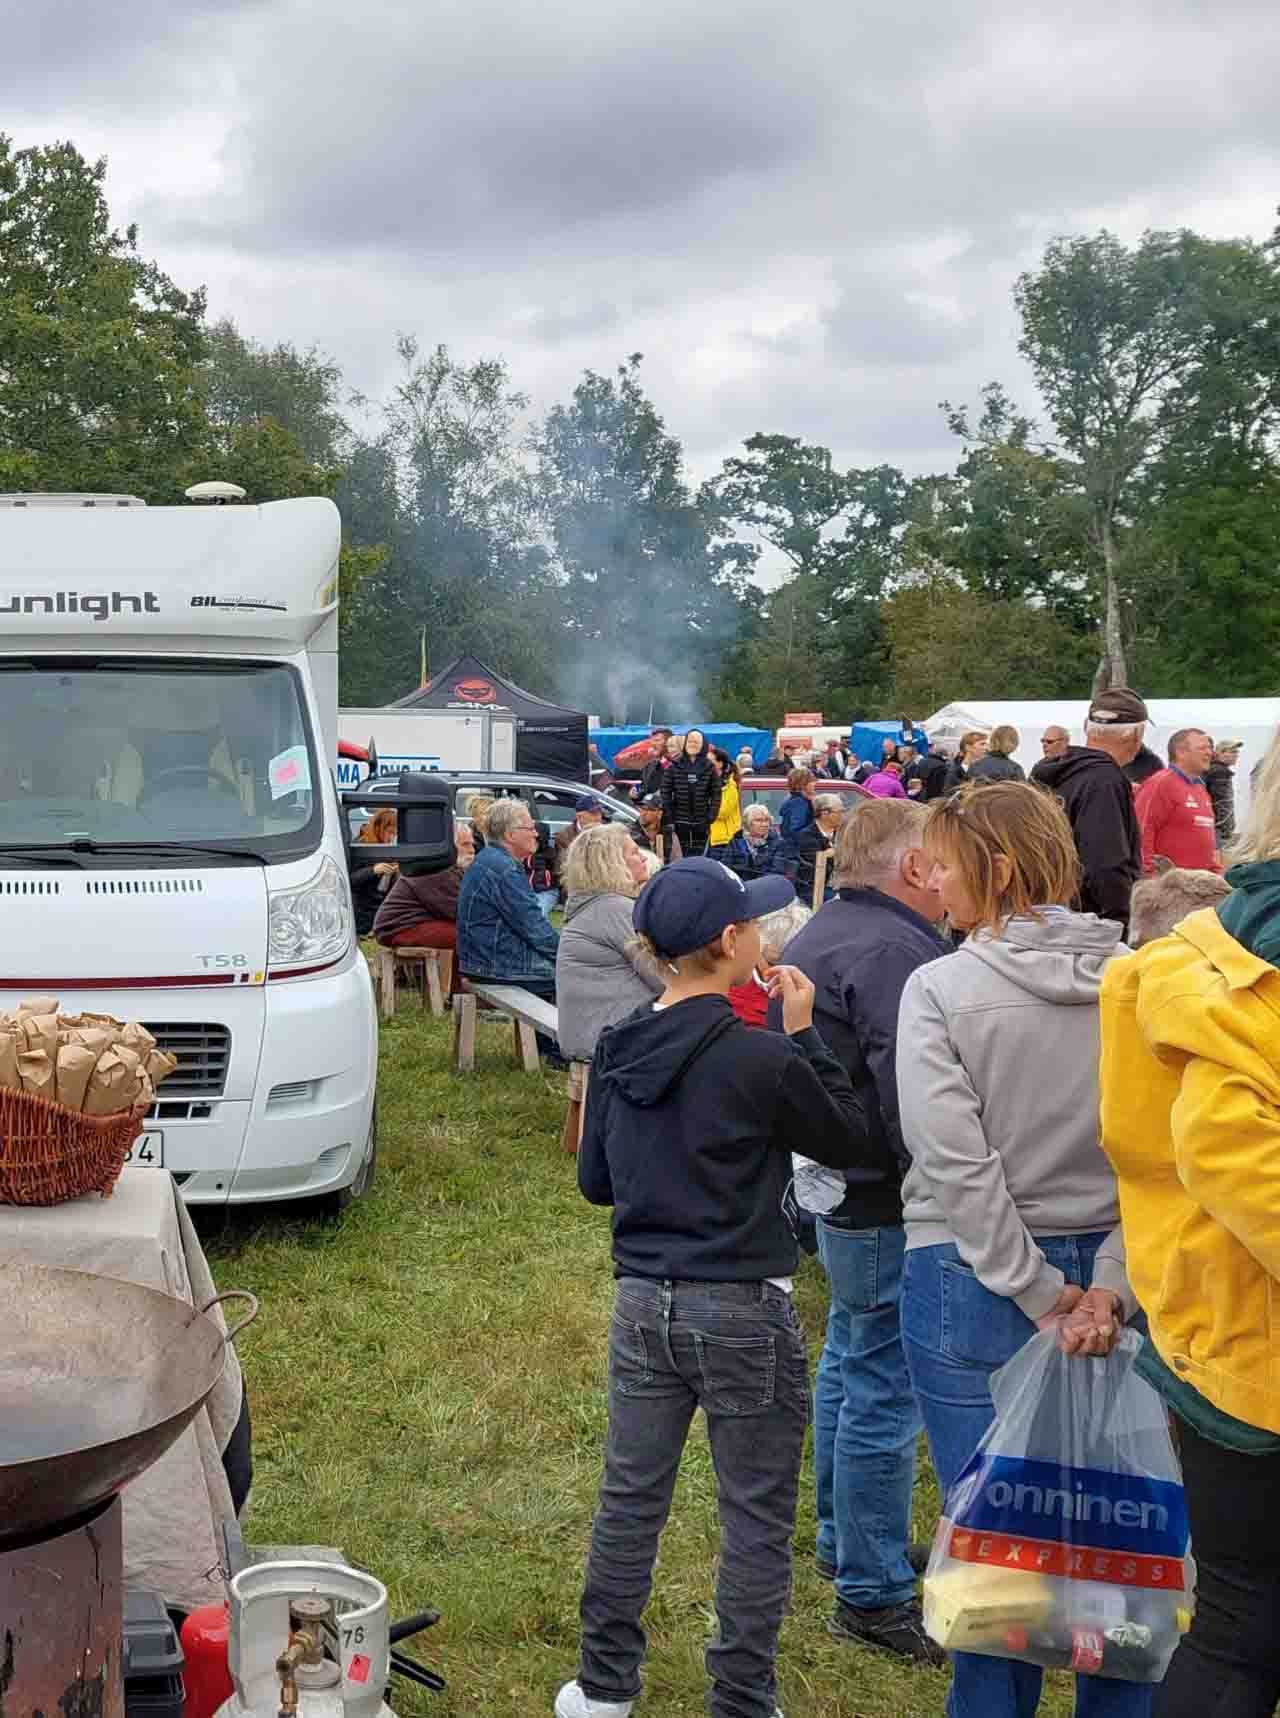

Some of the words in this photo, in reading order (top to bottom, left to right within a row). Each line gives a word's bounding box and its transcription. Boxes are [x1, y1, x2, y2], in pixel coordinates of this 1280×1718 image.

[195, 954, 248, 968] T58
[987, 1480, 1169, 1531] onninen
[343, 1625, 365, 1649] 76
